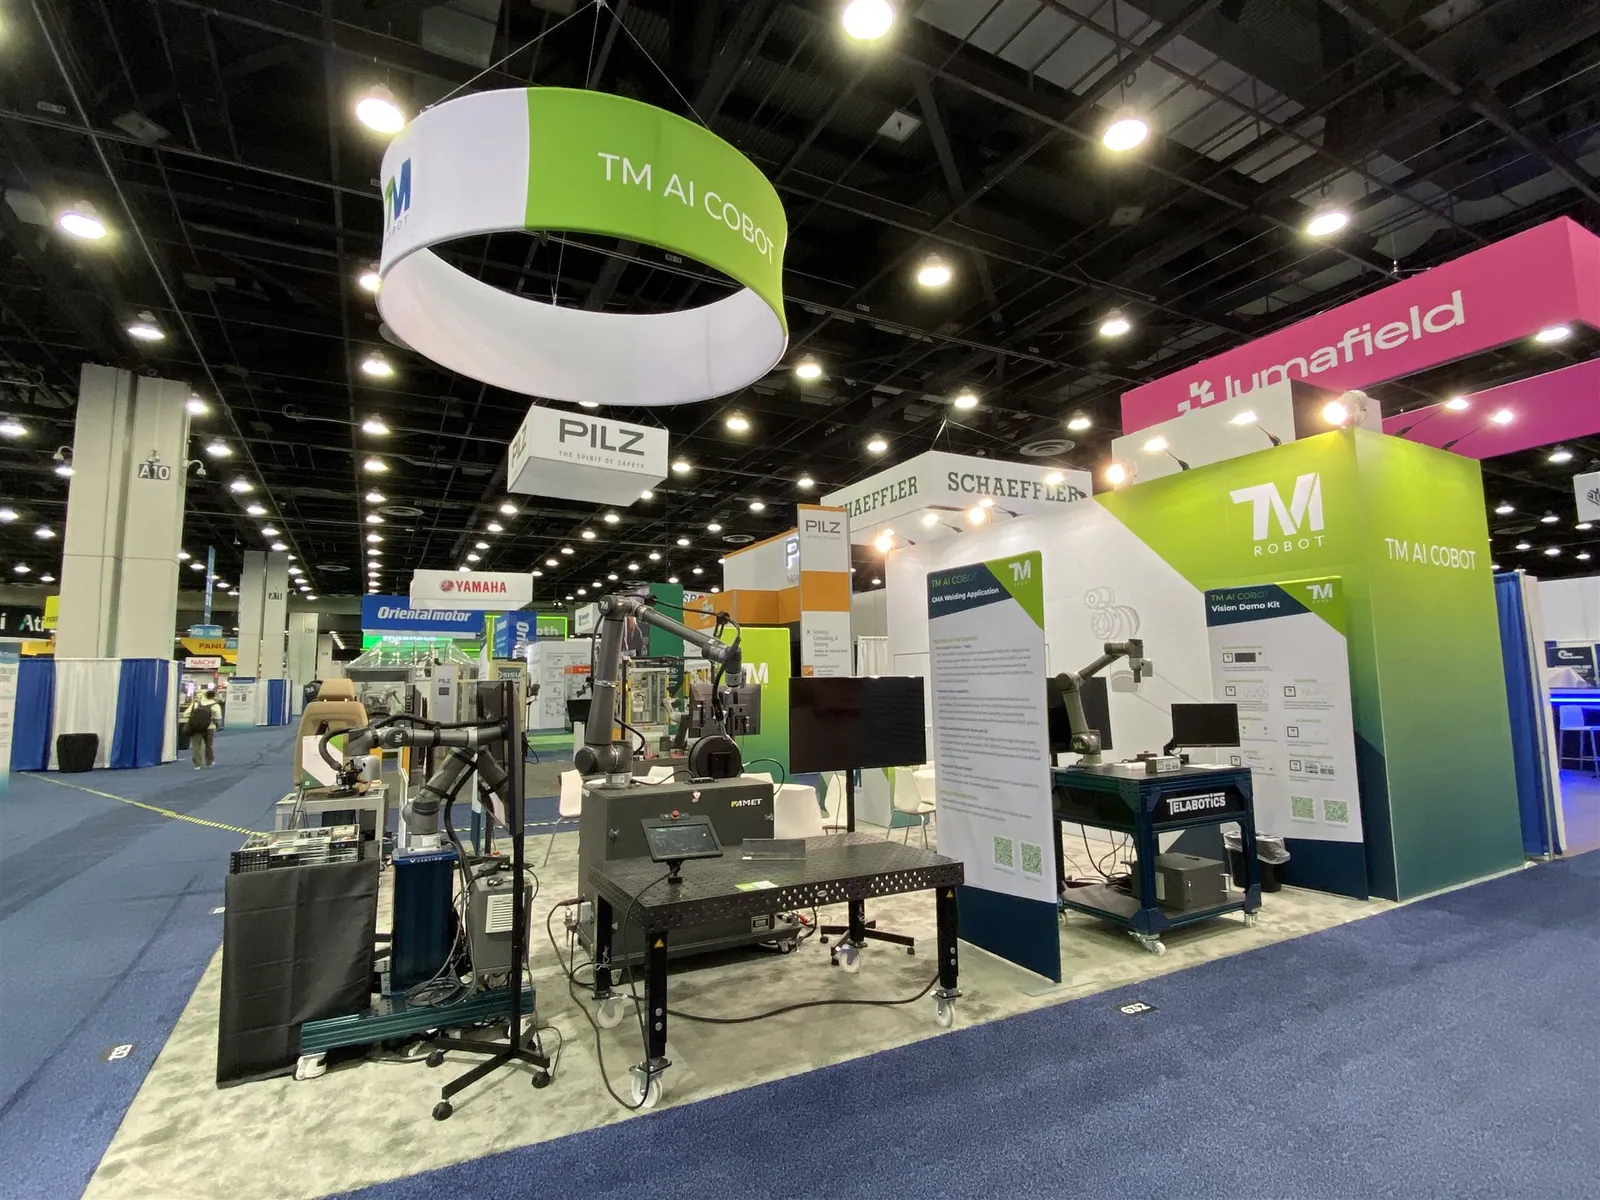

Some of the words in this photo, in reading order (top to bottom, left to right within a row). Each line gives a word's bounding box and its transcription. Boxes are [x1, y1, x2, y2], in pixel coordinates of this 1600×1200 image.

[597, 152, 652, 191] TM
[663, 173, 695, 208] AI
[704, 191, 775, 265] COBOT
[1225, 289, 1465, 402] lumafield
[511, 424, 527, 469] PILZ
[559, 418, 645, 456] PILZ
[558, 450, 573, 459] THE
[576, 453, 601, 463] SPIRIT
[617, 460, 645, 469] SAFETY
[139, 464, 170, 480] A10
[947, 471, 1080, 503] SCHAEFFLER
[839, 475, 918, 519] HAEFFLER
[1228, 472, 1326, 540] TM
[805, 519, 841, 534] PILZ
[1254, 535, 1326, 557] ROBOT
[1384, 537, 1409, 563] TM
[1413, 543, 1427, 565] AI
[1430, 545, 1476, 570] COBOT
[931, 579, 942, 588] TM
[943, 578, 951, 587] AI
[951, 571, 979, 585] COBOT
[1008, 559, 1031, 582] TM
[456, 580, 507, 593] YAMAHA
[944, 592, 966, 602] Welding
[966, 586, 1000, 599] Application
[1211, 594, 1224, 602] TM
[1237, 590, 1269, 600] COBOT
[1306, 583, 1333, 600] TM
[1211, 603, 1237, 613] Vision
[1239, 602, 1266, 611] Demo
[1267, 600, 1280, 609] Kit
[18, 614, 45, 632] Ati
[199, 642, 227, 650] FANU
